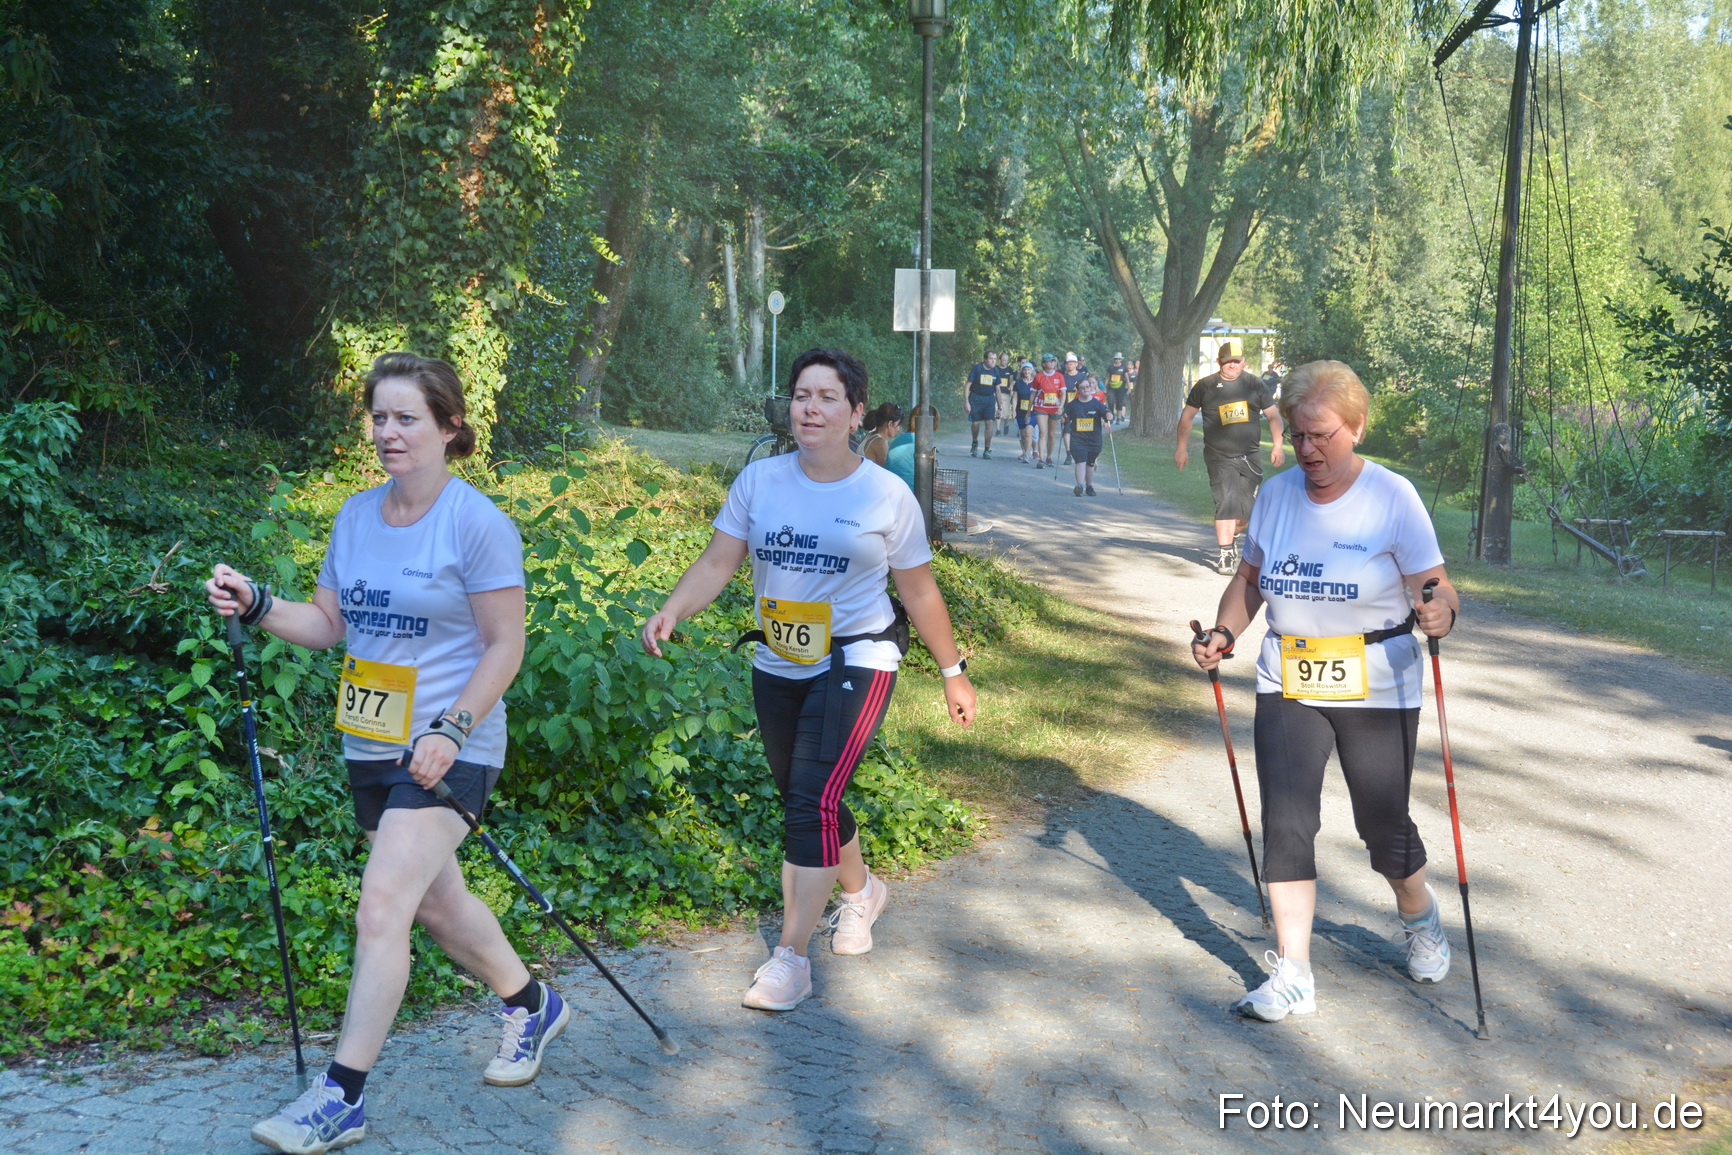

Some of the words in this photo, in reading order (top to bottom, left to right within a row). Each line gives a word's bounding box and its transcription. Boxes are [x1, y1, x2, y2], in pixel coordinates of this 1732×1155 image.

[835, 517, 860, 528] Kerstin
[765, 525, 819, 549] KÖNIG
[1333, 541, 1367, 552] Roswitha
[756, 548, 850, 573] Engineering
[1271, 553, 1324, 577] KÖNIG
[402, 567, 433, 579] Corinna
[341, 579, 391, 608] KÖNIG
[1260, 575, 1358, 599] Engineering
[375, 629, 391, 637] your
[392, 631, 413, 639] tools
[771, 620, 811, 646] 976
[789, 645, 809, 654] Kerstin
[1298, 659, 1346, 682] 975
[345, 684, 389, 717] 977
[360, 716, 386, 728] Corinna
